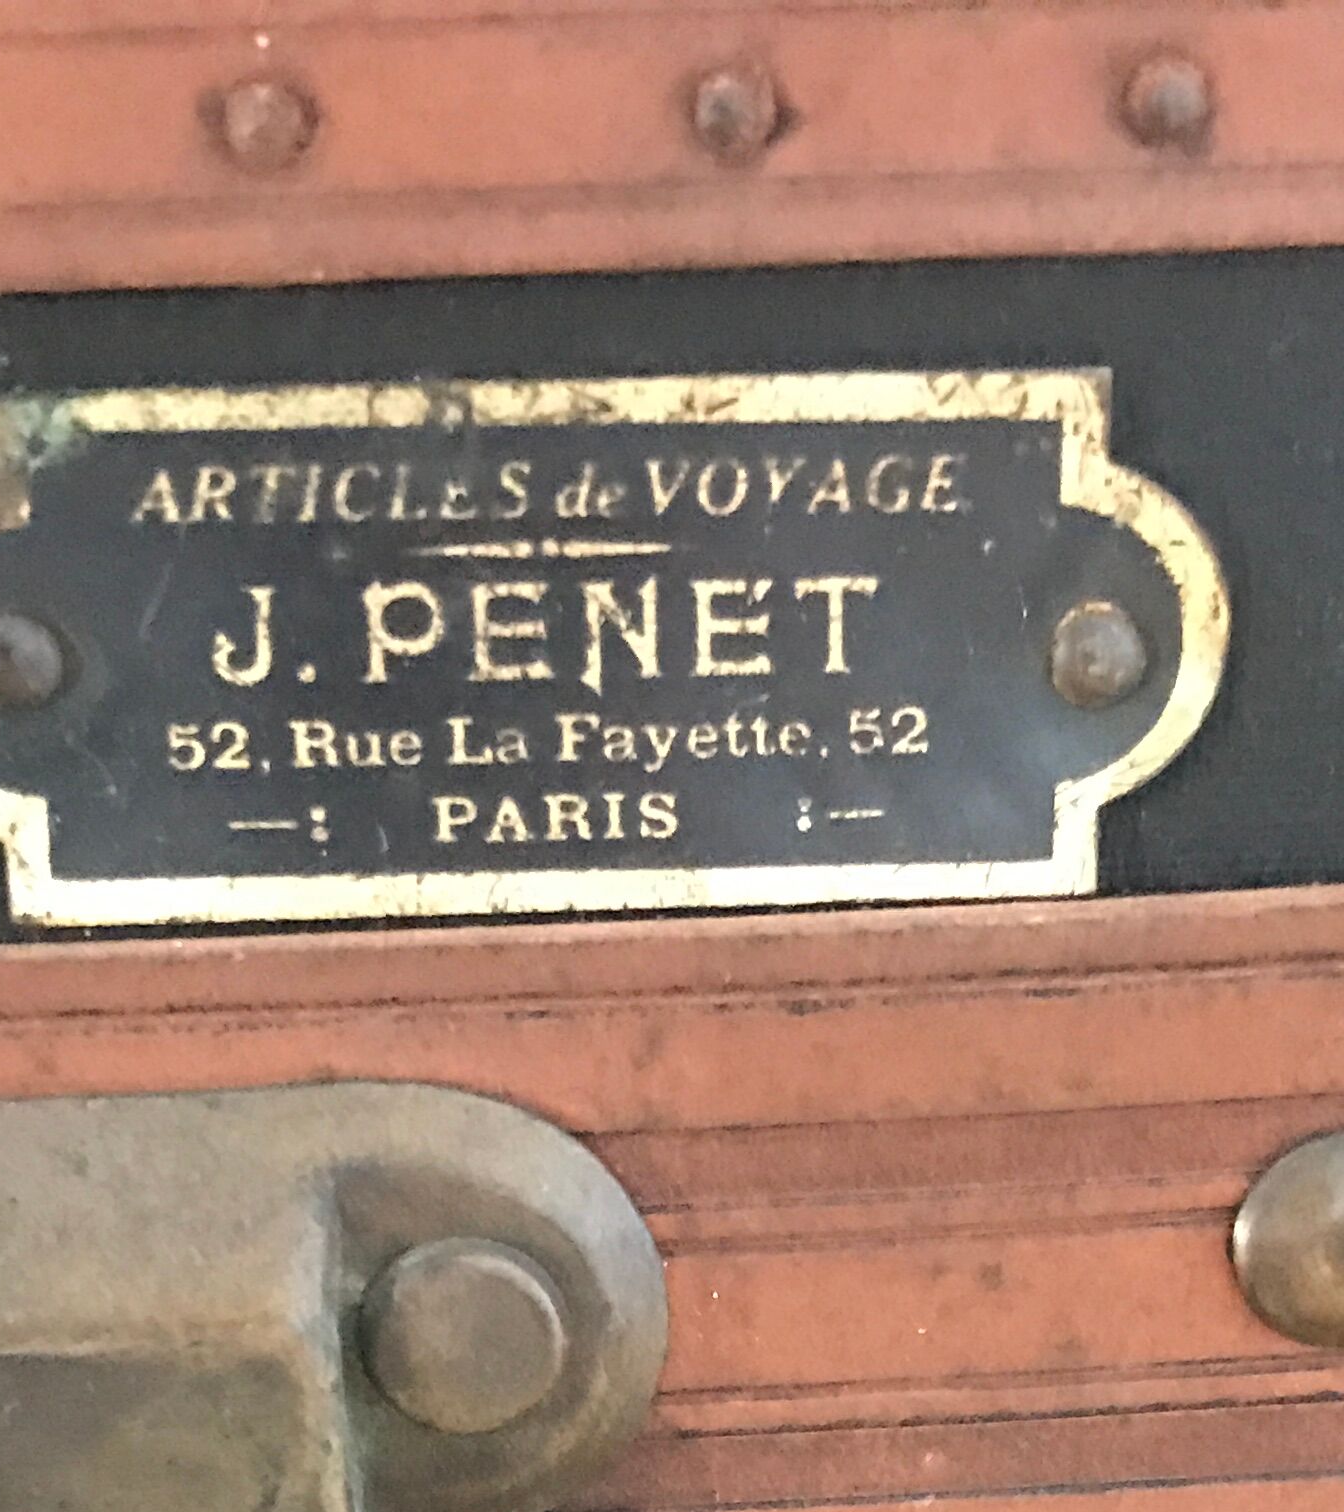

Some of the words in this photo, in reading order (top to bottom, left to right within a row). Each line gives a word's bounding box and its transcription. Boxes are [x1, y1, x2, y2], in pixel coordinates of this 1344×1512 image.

[129, 458, 532, 524] ARTICLES
[555, 459, 627, 518] de
[643, 452, 972, 517] VOYAGE
[211, 584, 317, 688] J.
[361, 573, 880, 696] PENET
[288, 719, 424, 770] Rue
[445, 714, 530, 766] La
[848, 705, 930, 756] 52
[430, 792, 681, 845] PARIS
